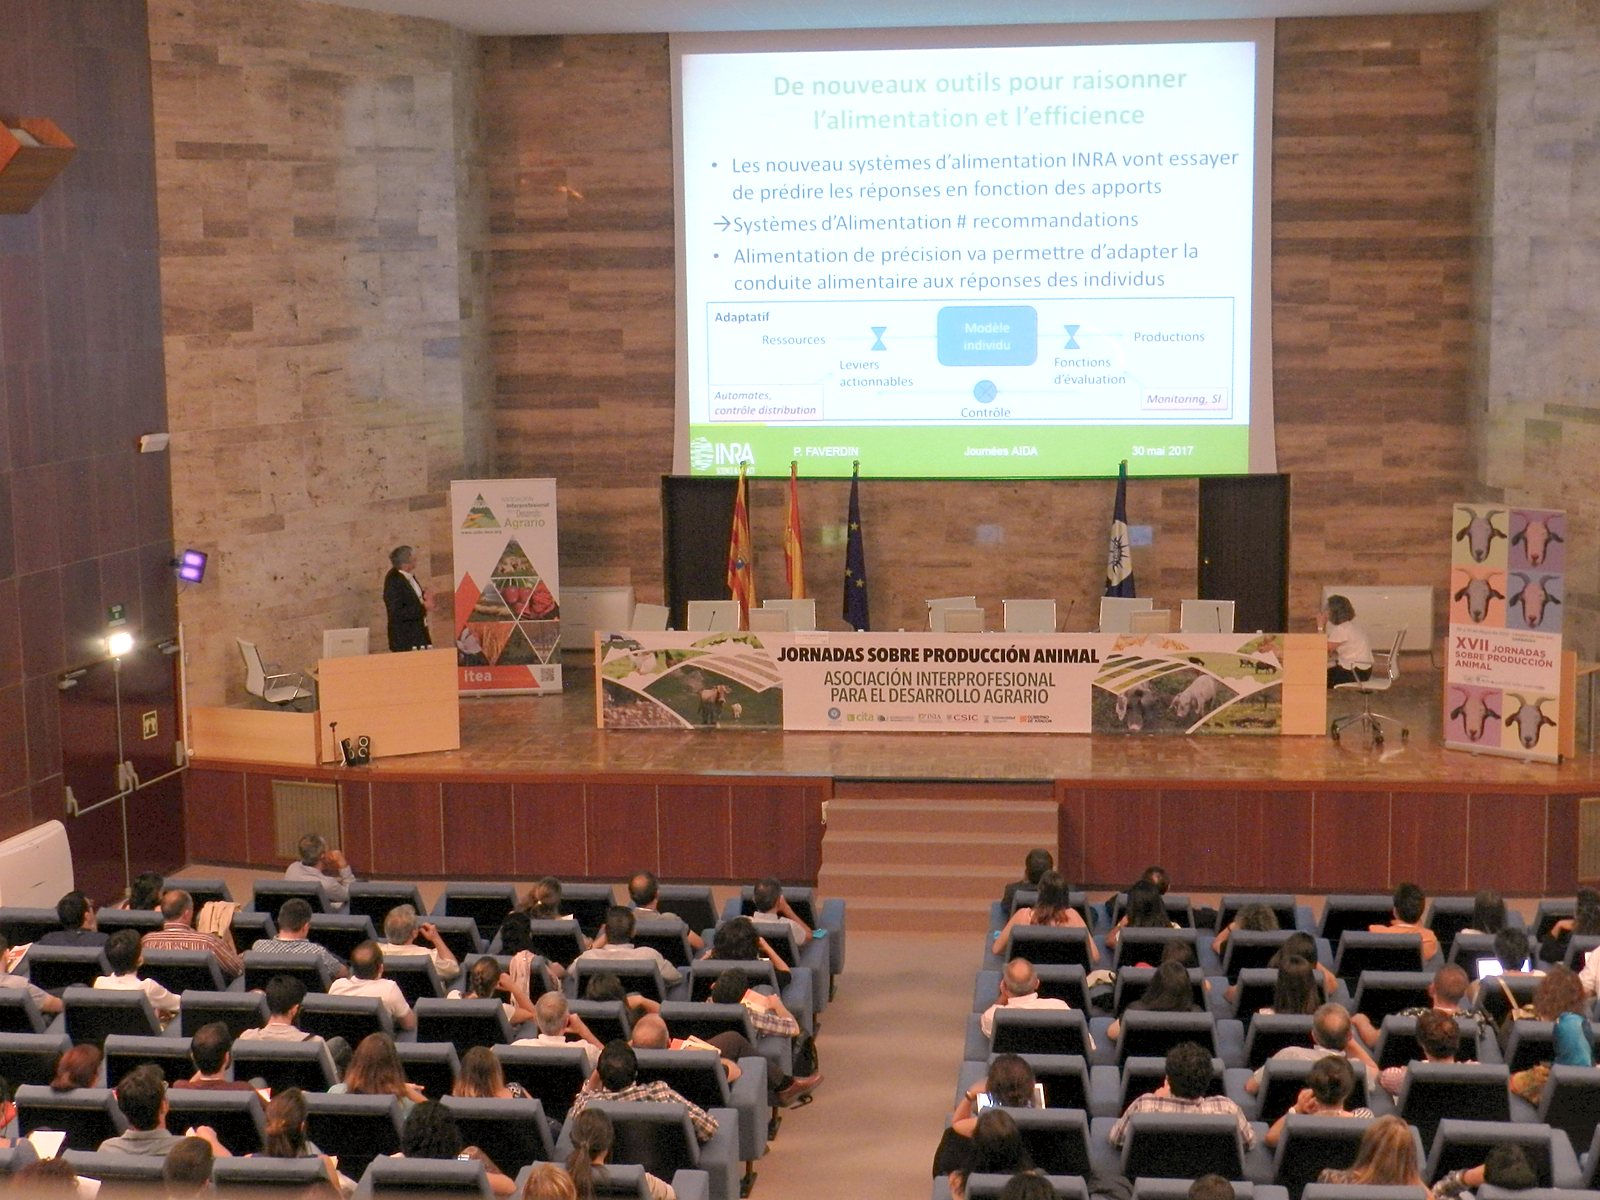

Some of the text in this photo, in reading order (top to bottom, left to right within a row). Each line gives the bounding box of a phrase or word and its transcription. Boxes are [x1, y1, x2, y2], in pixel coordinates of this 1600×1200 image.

[773, 70, 1187, 95] De nouveaux outils pour raisonner
[813, 105, 1145, 130] l'alimentation et l'efficience
[732, 152, 1239, 175] Les nouveau systèmes d'alimentation INRA vont essayer
[732, 179, 1162, 203] de prédire les réponses en fonction des apports
[733, 211, 1139, 235] Systèmes d'Alimentation # recommandations
[733, 243, 1199, 266] Alimentation de précision va permettre d'adapter la
[734, 270, 1166, 291] conduite alimentaire aux réponses des individus
[714, 311, 770, 325] Adaptatif
[965, 322, 1010, 334] Modèle
[762, 335, 826, 346] Ressources
[1134, 332, 1205, 343] Productions
[963, 339, 1011, 351] individu
[839, 360, 880, 371] Leviers
[1054, 357, 1111, 368] Fonctions
[839, 376, 914, 387] actionnables
[714, 404, 817, 416] contrôle distribution
[961, 406, 1011, 418] Contrôle
[715, 442, 755, 465] INRA
[793, 446, 859, 457] P. FAVERDIN
[963, 445, 1038, 457] Journées AIDA
[1131, 445, 1194, 456] 30 mai 2017
[504, 518, 546, 529] Agrario
[1456, 636, 1546, 658] XVII JORNADAS
[776, 644, 1100, 663] JORNADAS SOBRE PRODUCCIÓN ANIMAL
[1455, 651, 1485, 660] SOBRE
[1455, 659, 1492, 671] ANIMAL
[464, 670, 492, 683] itea
[823, 667, 1056, 687] ASOCIACIÓN INTERPROFESIONAL
[831, 687, 1049, 704] PARA EL DESARROLLO AGRARIO
[856, 711, 874, 722] cita
